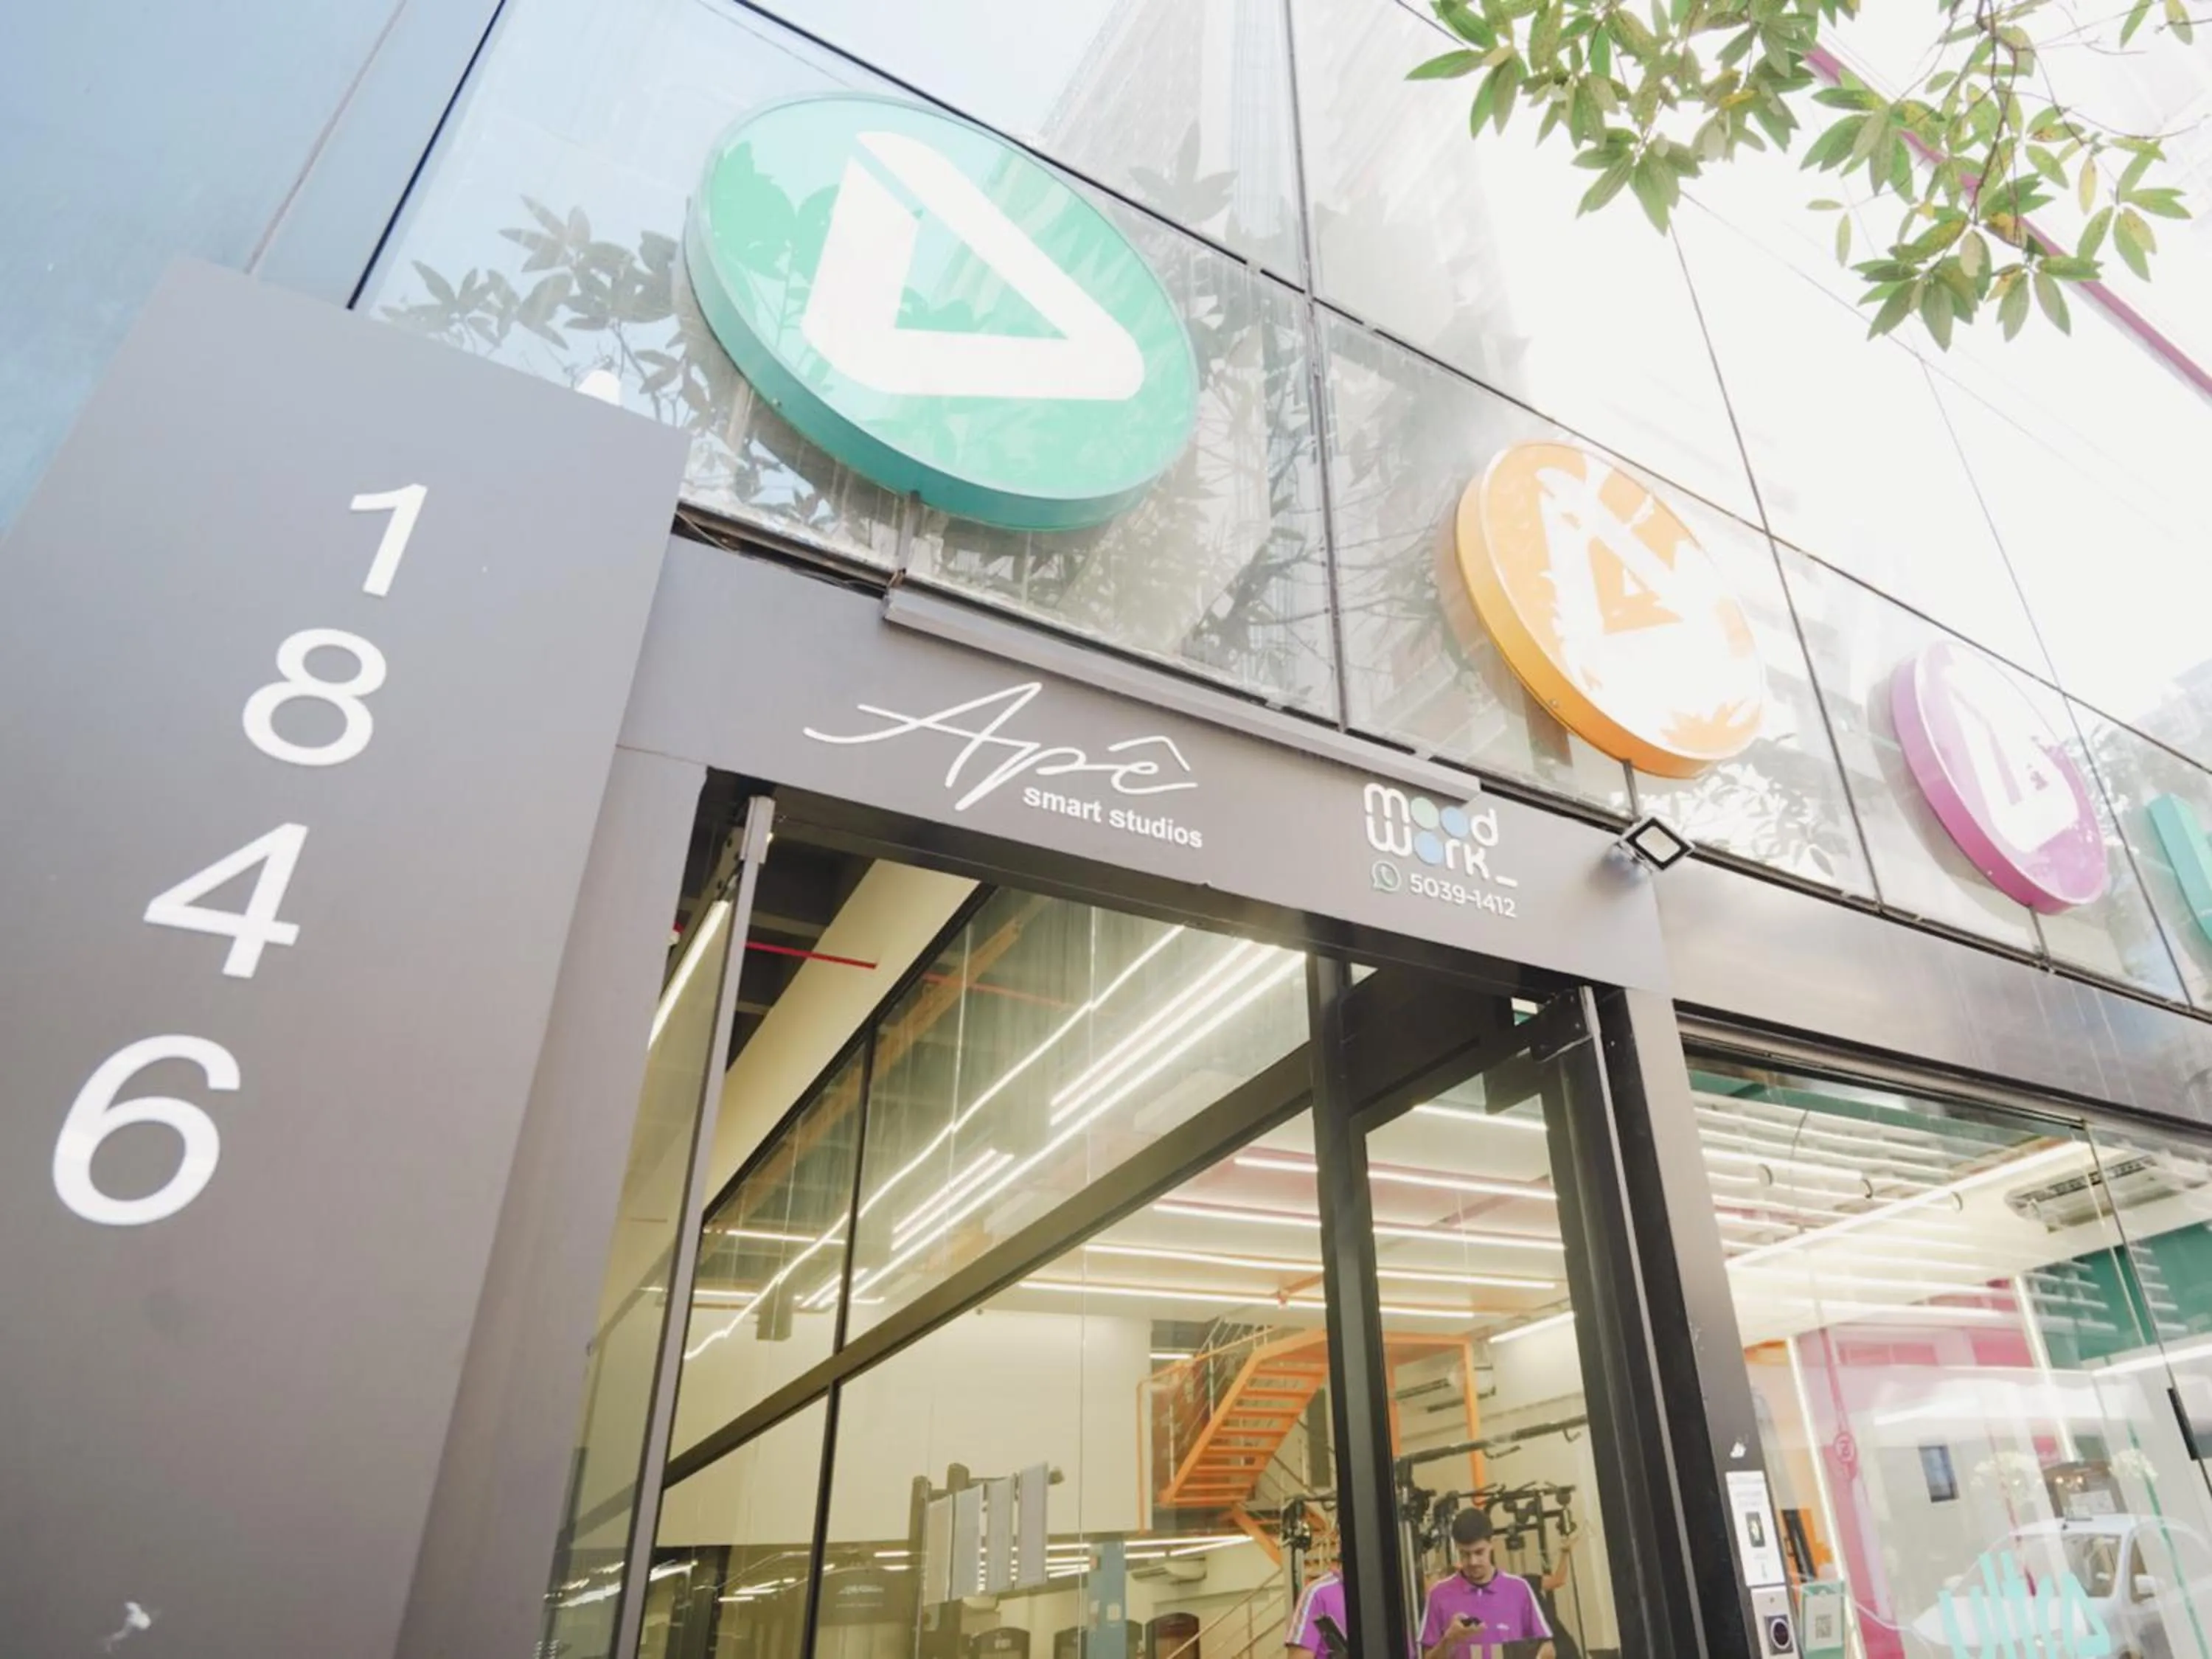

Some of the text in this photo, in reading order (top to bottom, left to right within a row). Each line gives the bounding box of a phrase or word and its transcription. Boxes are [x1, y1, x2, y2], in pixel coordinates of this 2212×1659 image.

[802, 681, 1198, 811] Apê
[1023, 785, 1203, 849] smart studios
[1409, 873, 1517, 919] 5039-1412
